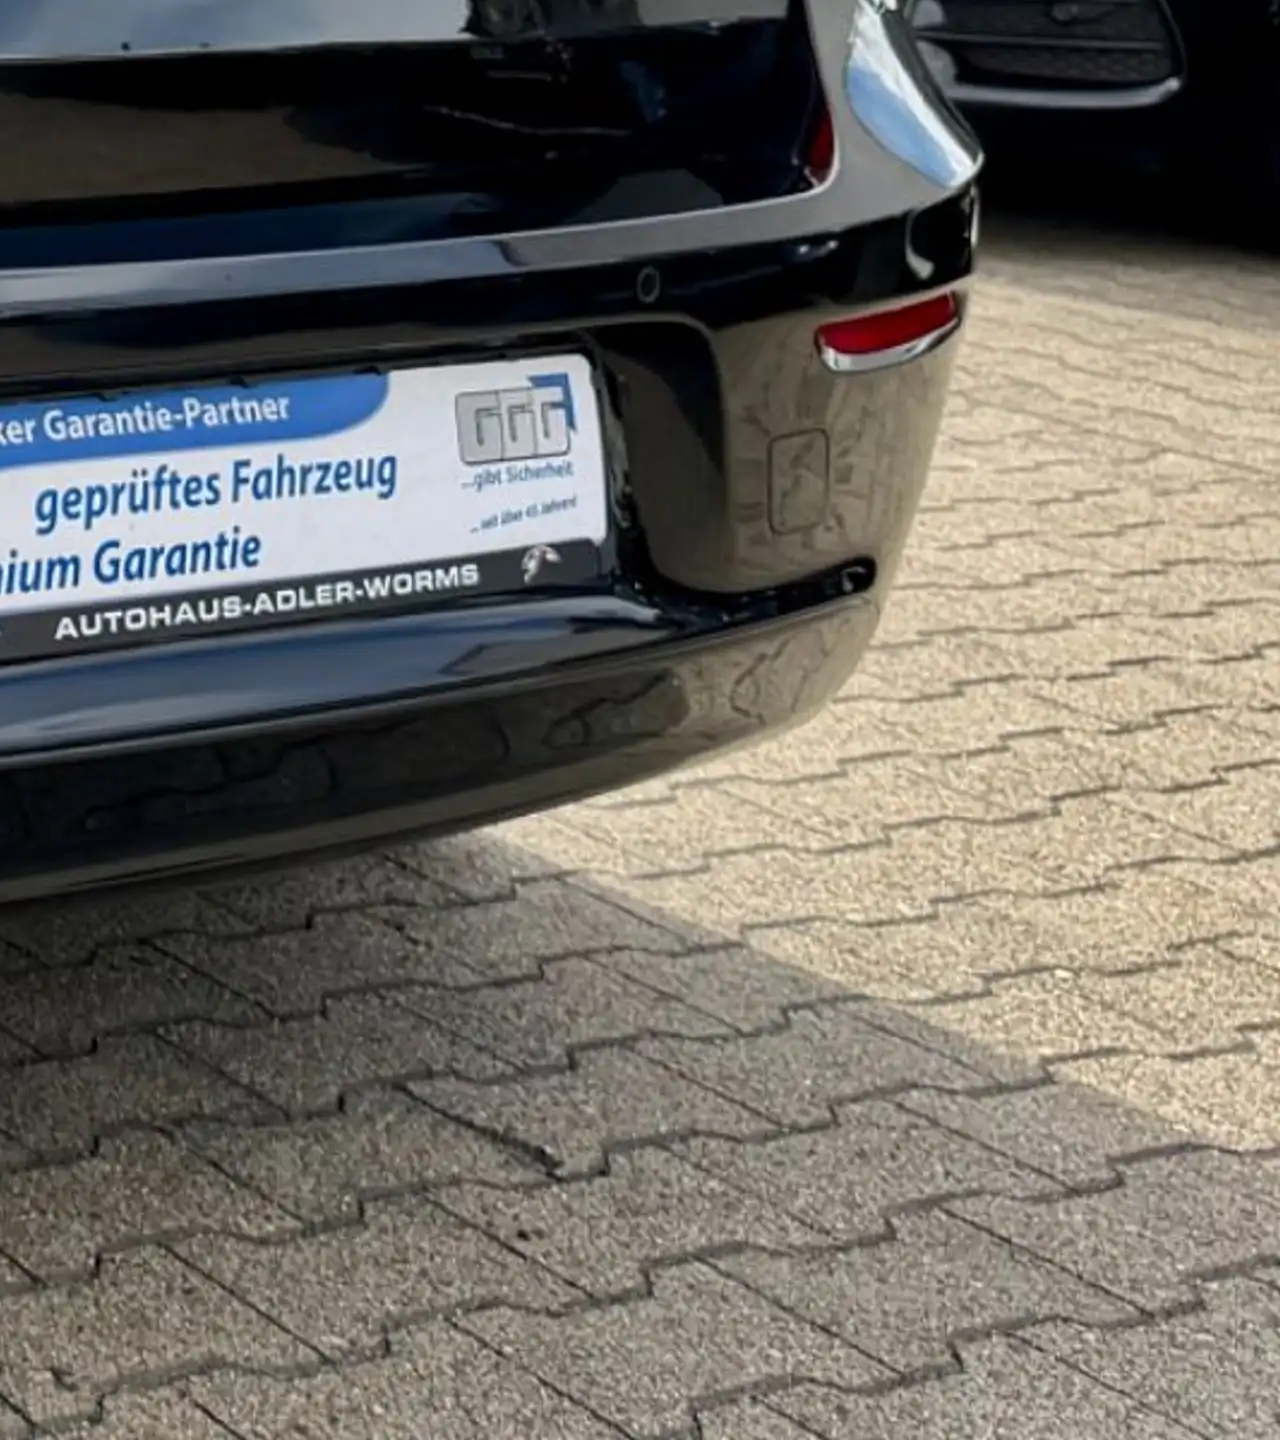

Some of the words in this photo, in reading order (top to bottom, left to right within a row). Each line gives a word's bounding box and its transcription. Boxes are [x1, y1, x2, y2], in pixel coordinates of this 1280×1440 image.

[43, 393, 291, 442] Garantie-Partner
[34, 463, 220, 535] geprüftes
[231, 453, 397, 503] Fahrzeug
[506, 461, 574, 483] Sicherheit
[93, 526, 261, 584] Garantie
[53, 563, 480, 641] AUTOHAUS-ADLER-WORMS
